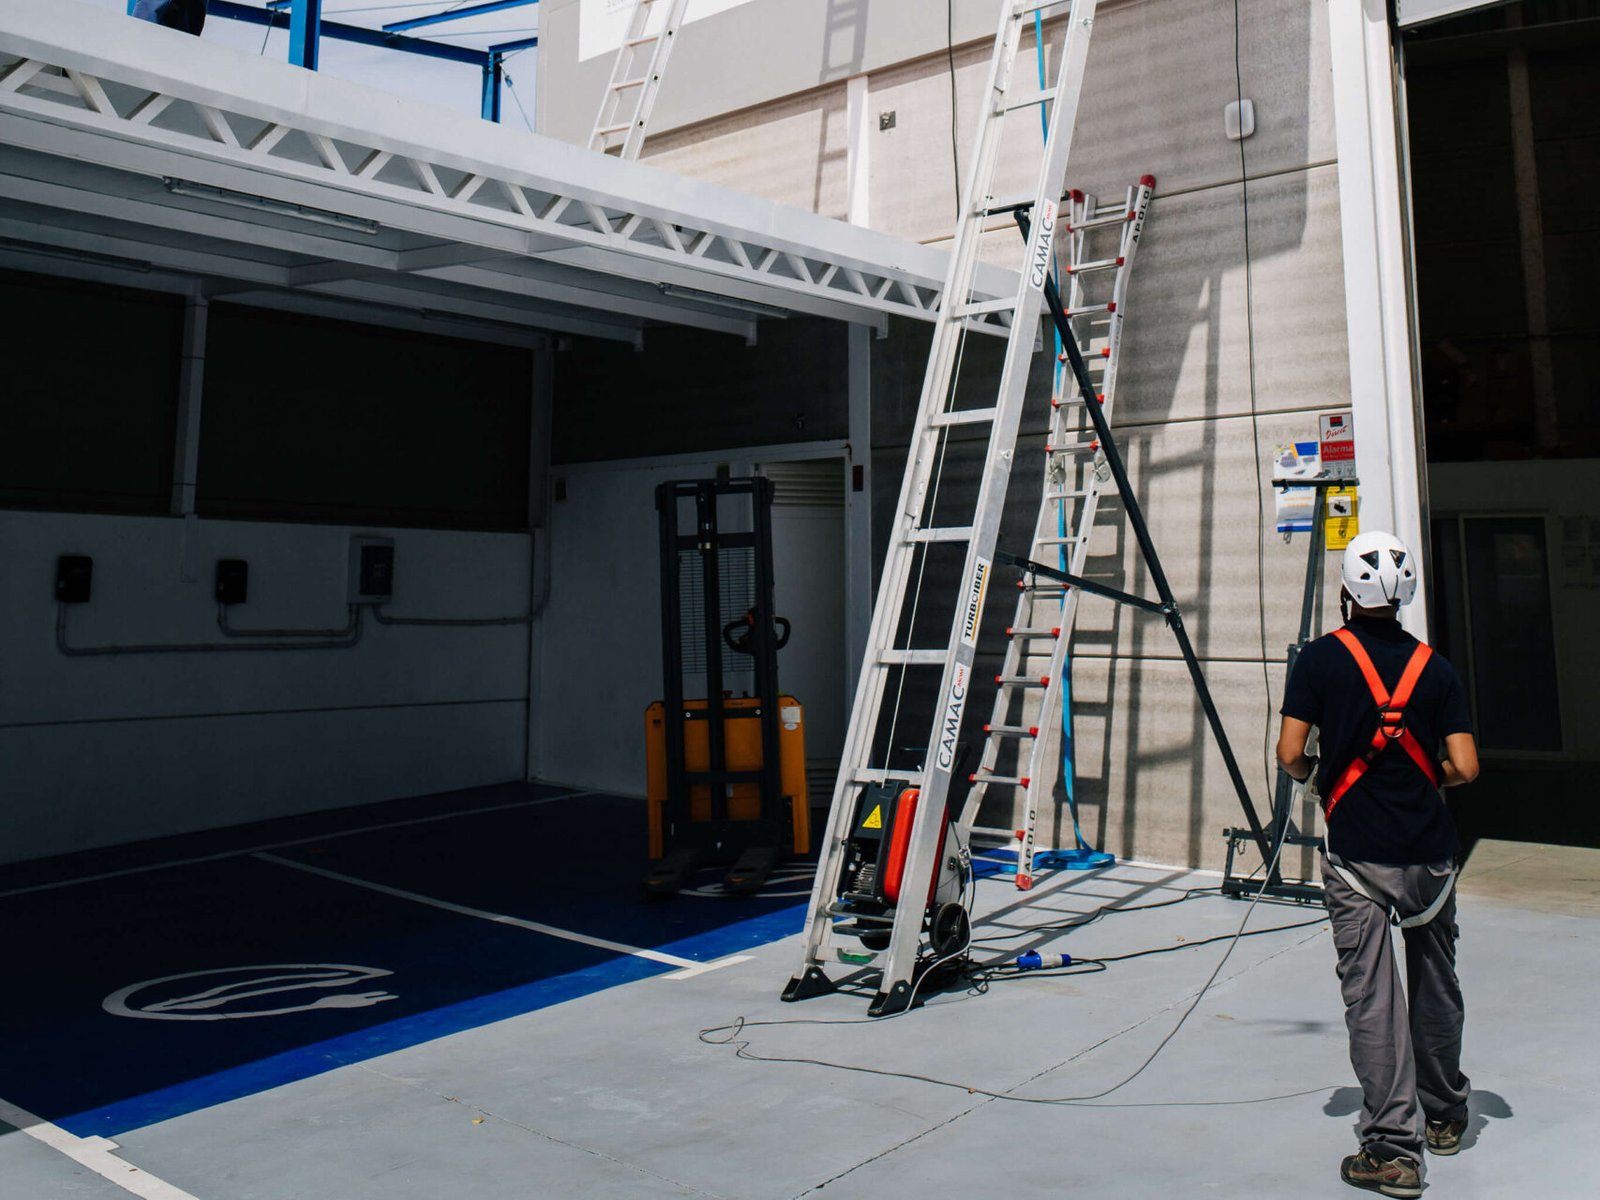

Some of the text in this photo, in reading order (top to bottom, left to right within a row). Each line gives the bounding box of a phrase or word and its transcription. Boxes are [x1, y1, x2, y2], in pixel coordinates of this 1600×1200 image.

[1032, 217, 1053, 288] CAMAC
[1132, 190, 1150, 244] APOLO
[964, 562, 985, 639] TURBOIBER
[939, 684, 965, 769] CAMAC
[1024, 810, 1036, 872] APOLO
